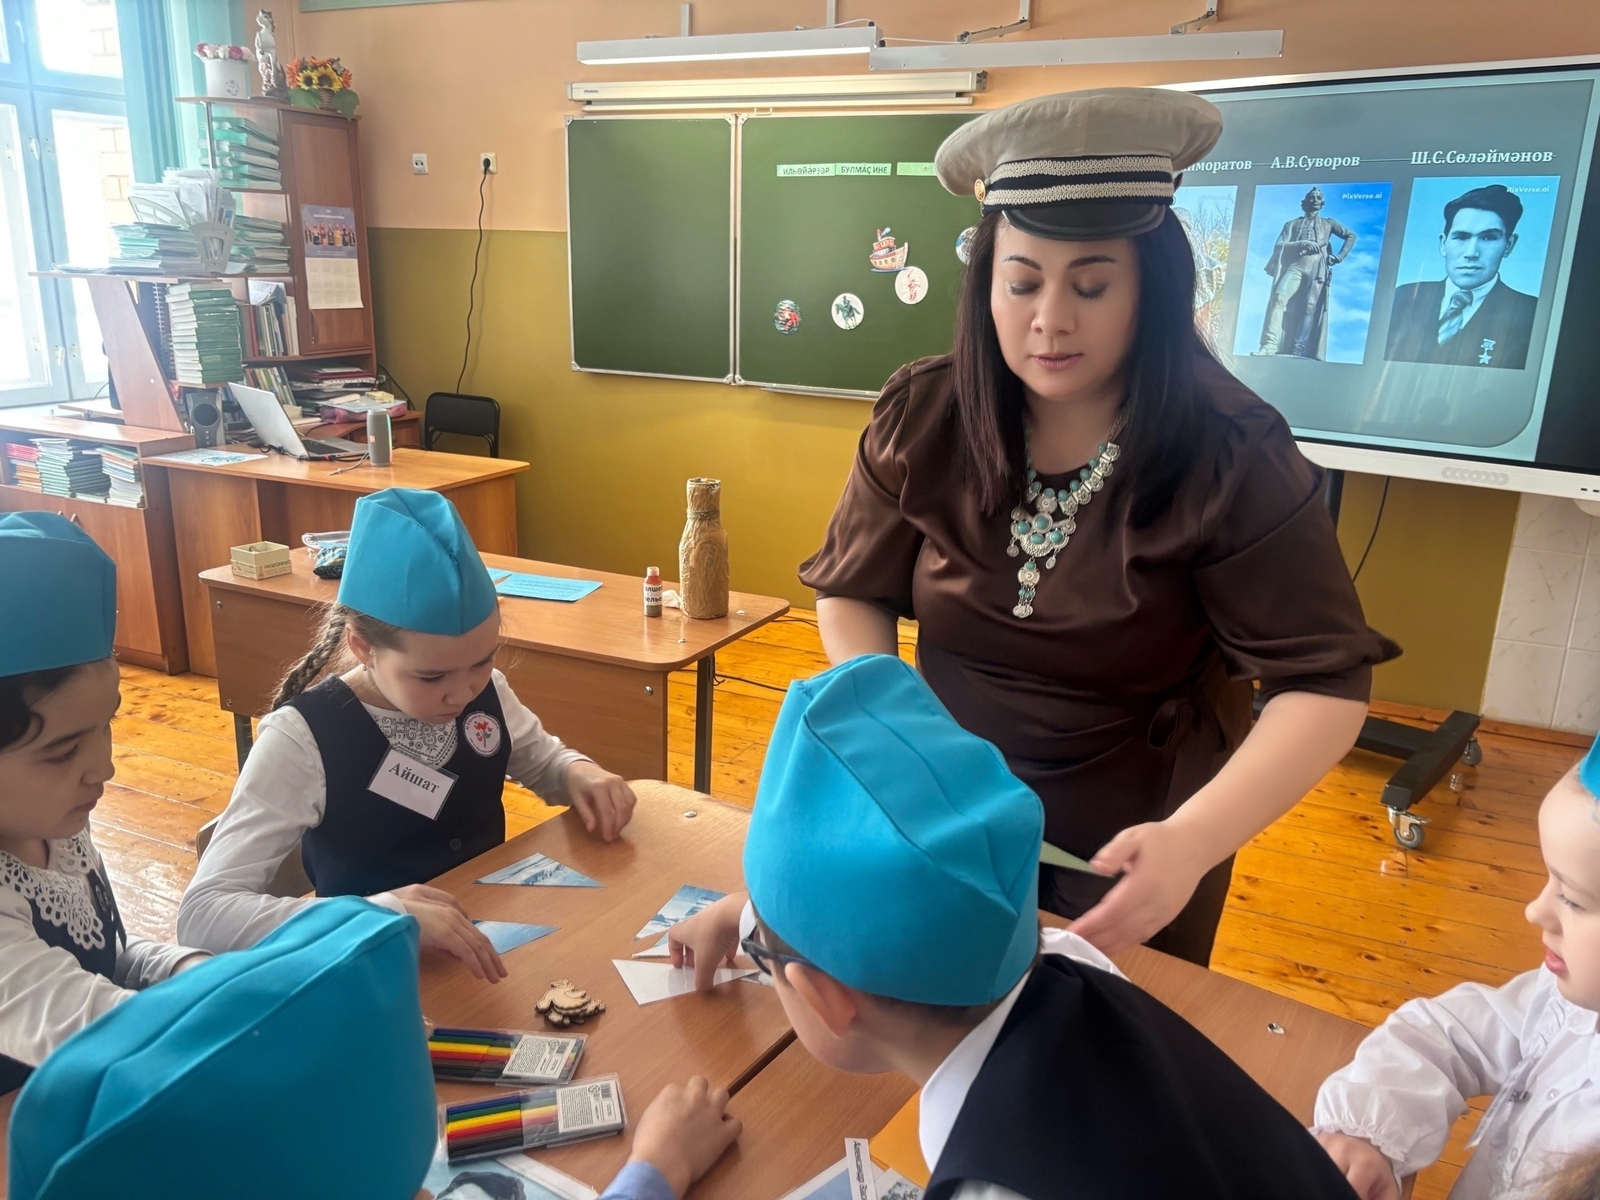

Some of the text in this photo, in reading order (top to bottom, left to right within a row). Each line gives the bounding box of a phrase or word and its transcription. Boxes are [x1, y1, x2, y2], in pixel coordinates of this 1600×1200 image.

[1270, 155, 1360, 170] А.В.Суворов
[1410, 149, 1553, 165] Ш.С.Сөләймәнов
[388, 762, 440, 794] Айшат
